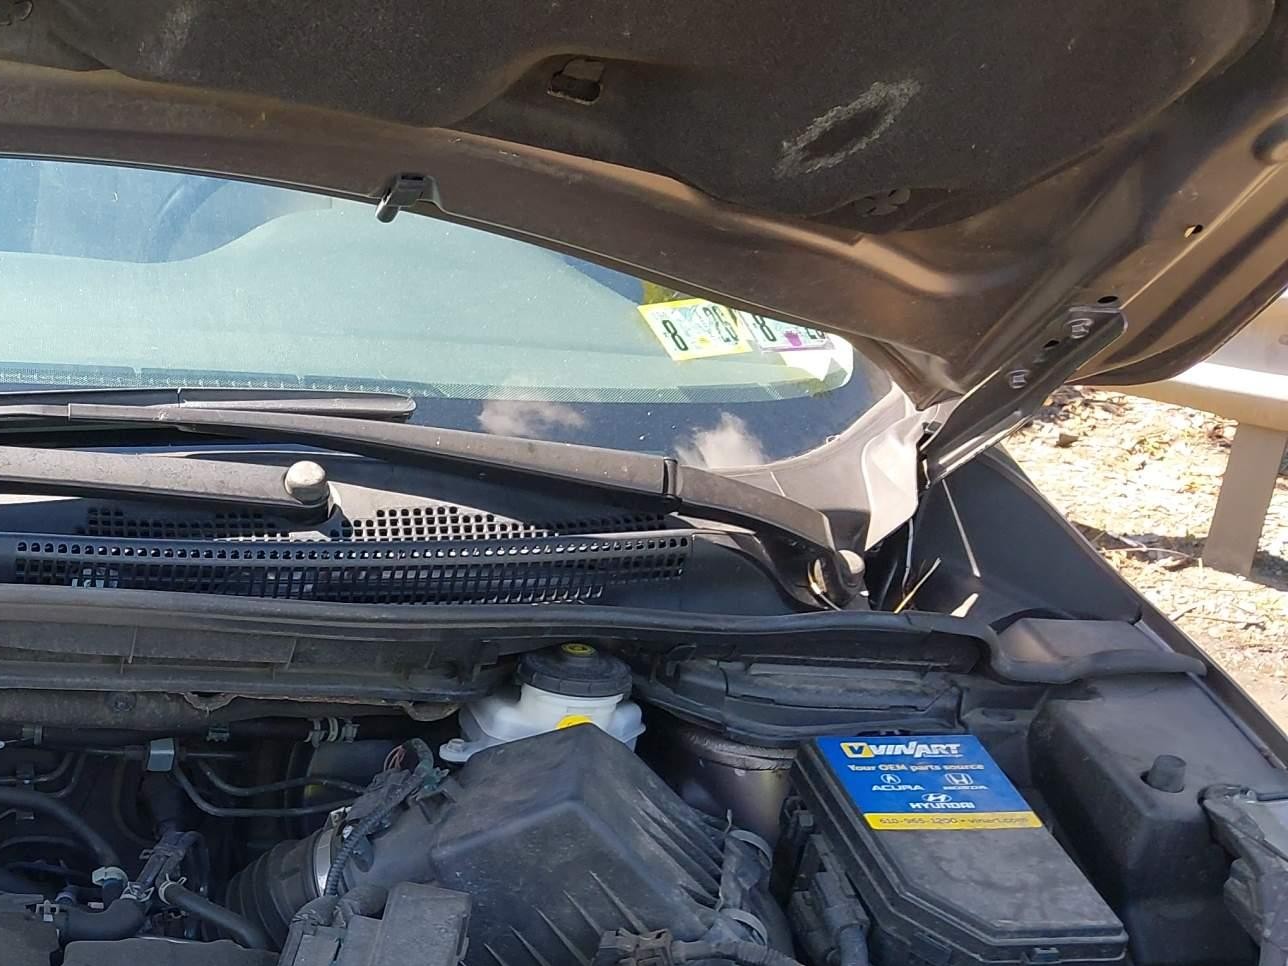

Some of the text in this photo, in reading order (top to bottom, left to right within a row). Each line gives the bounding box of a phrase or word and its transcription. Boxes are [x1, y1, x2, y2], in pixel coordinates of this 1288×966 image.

[662, 319, 689, 351] 8
[878, 763, 908, 771] OEM
[910, 763, 941, 772] parts
